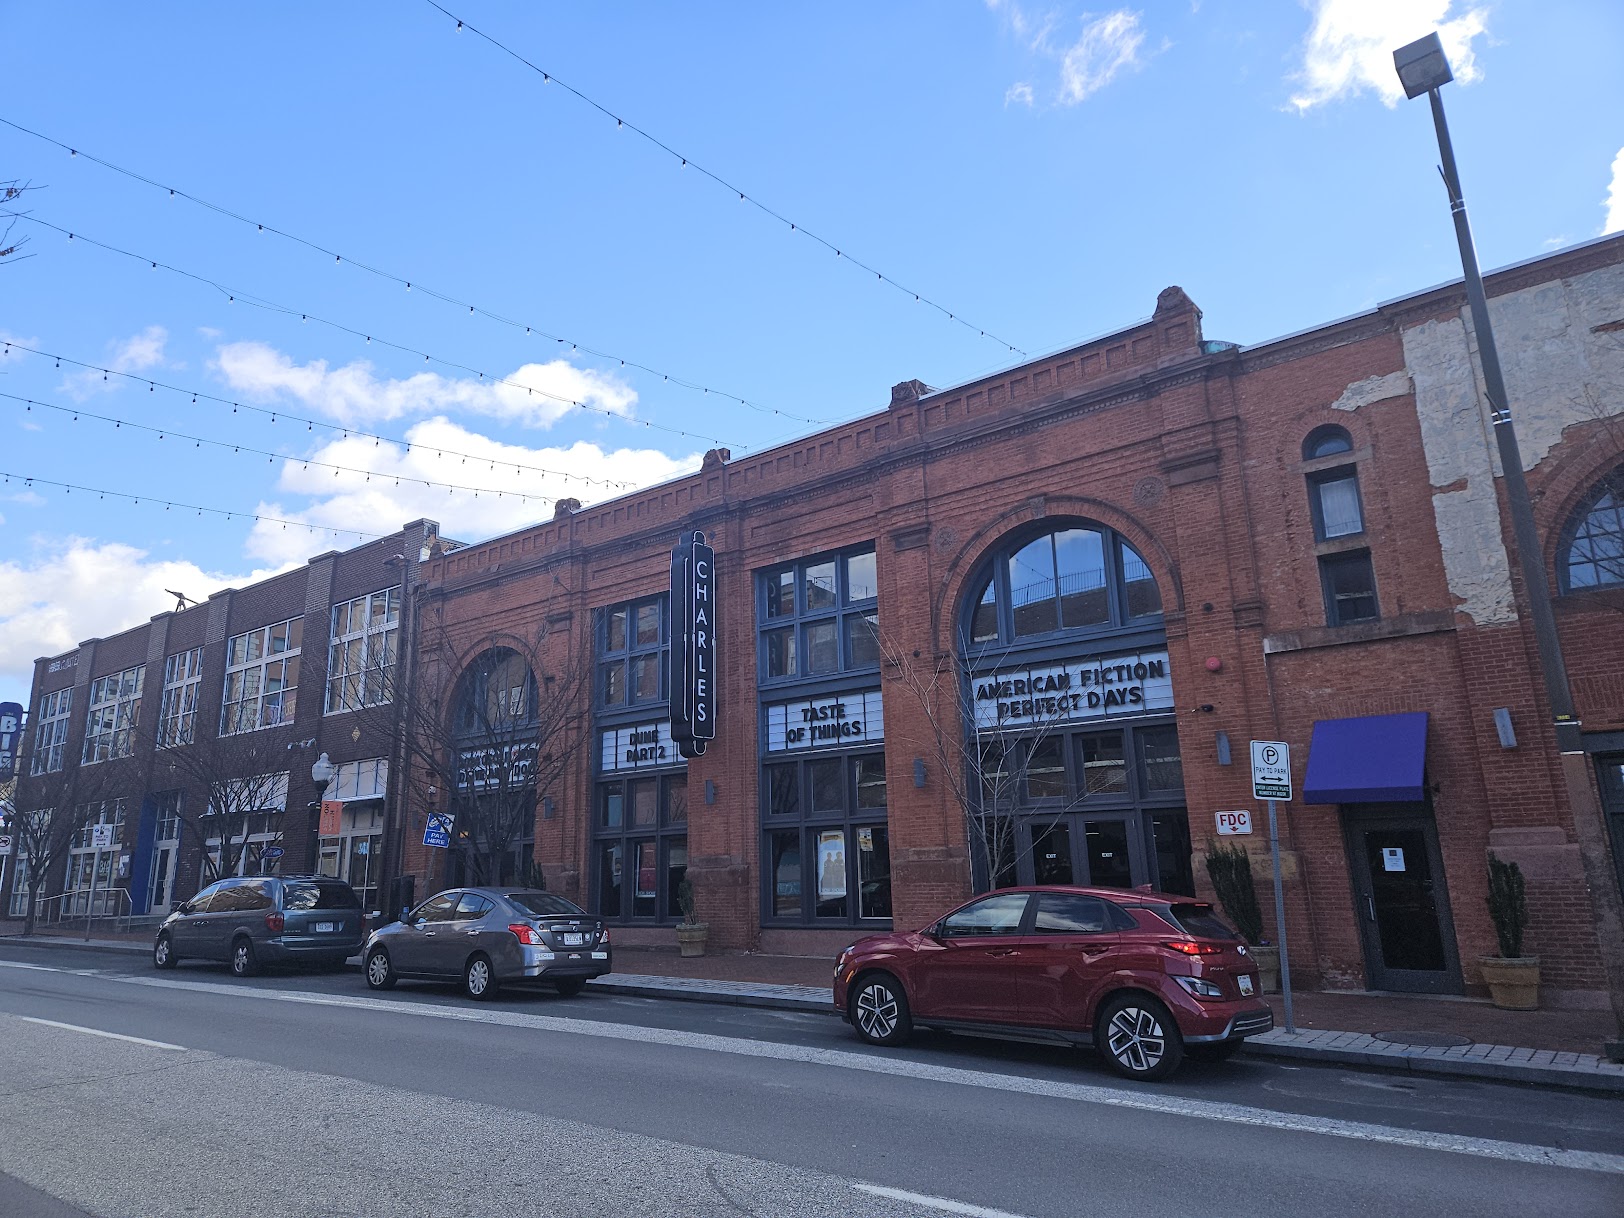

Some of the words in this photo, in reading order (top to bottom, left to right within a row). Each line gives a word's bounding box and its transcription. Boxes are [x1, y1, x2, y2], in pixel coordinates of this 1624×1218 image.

[696, 561, 708, 722] CHARLES
[976, 672, 1071, 701] AMERICAN
[1081, 659, 1164, 688] FICTION
[801, 703, 846, 722] TASTE
[999, 692, 1081, 719] PERFECT
[1087, 686, 1142, 709] DAYS
[629, 730, 658, 745] DUNE
[786, 727, 805, 743] OF
[809, 720, 862, 741] THINGS
[626, 747, 655, 762] PART
[658, 746, 665, 759] 2
[1219, 813, 1247, 826] FDC
